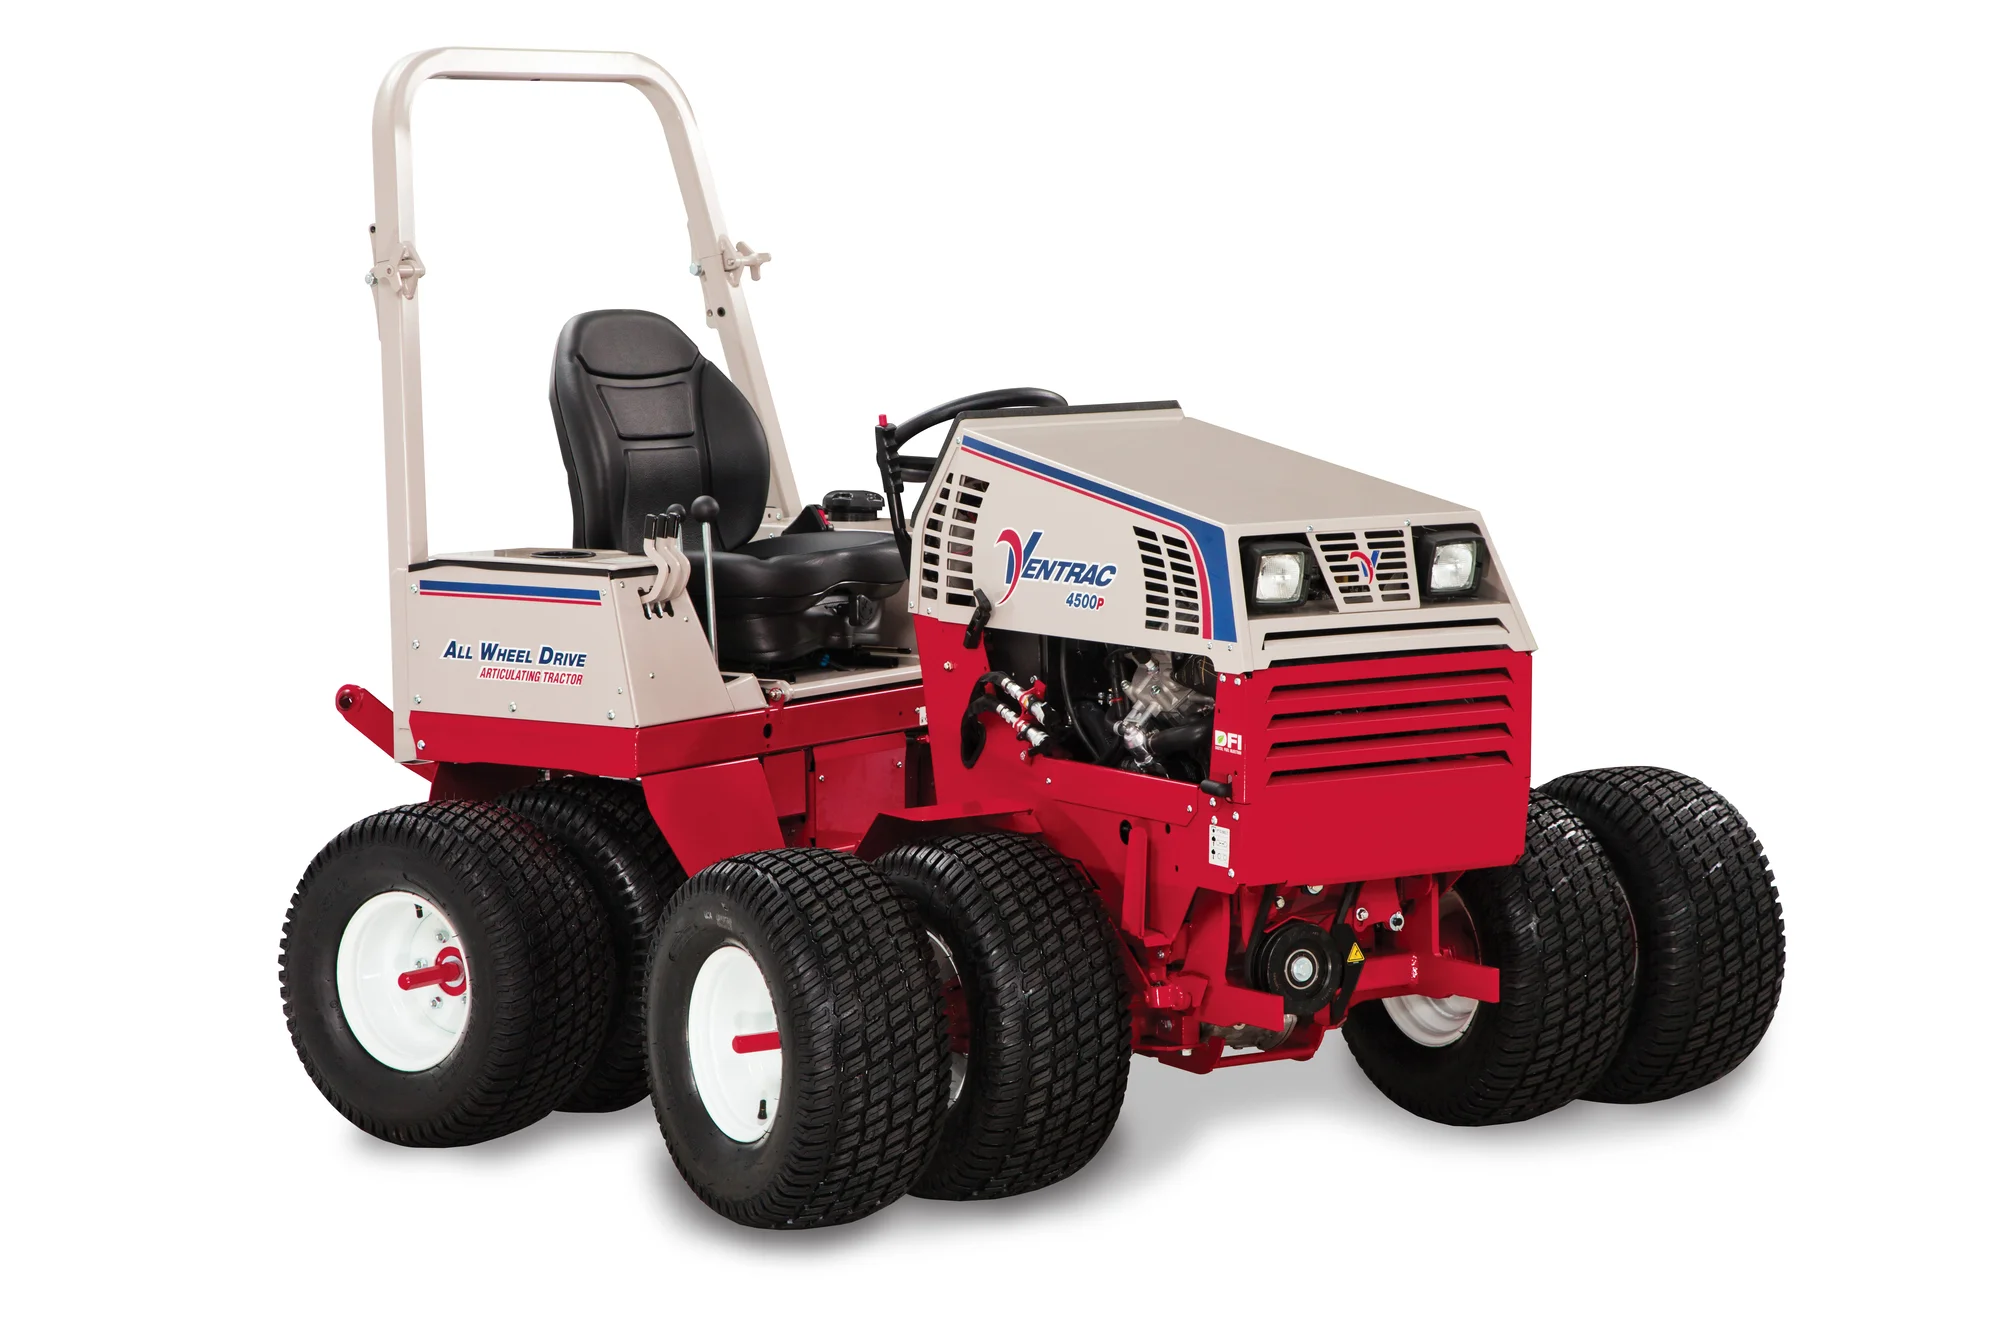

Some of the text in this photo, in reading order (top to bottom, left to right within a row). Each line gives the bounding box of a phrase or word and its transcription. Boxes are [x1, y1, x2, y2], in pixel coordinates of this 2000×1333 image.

[996, 529, 1116, 604] VENTRAC
[1065, 592, 1105, 610] 4500P
[443, 640, 587, 667] ALL WHEEL DRIVE
[479, 667, 583, 685] ARTICULATING TRACTOR
[1214, 730, 1243, 750] DFI
